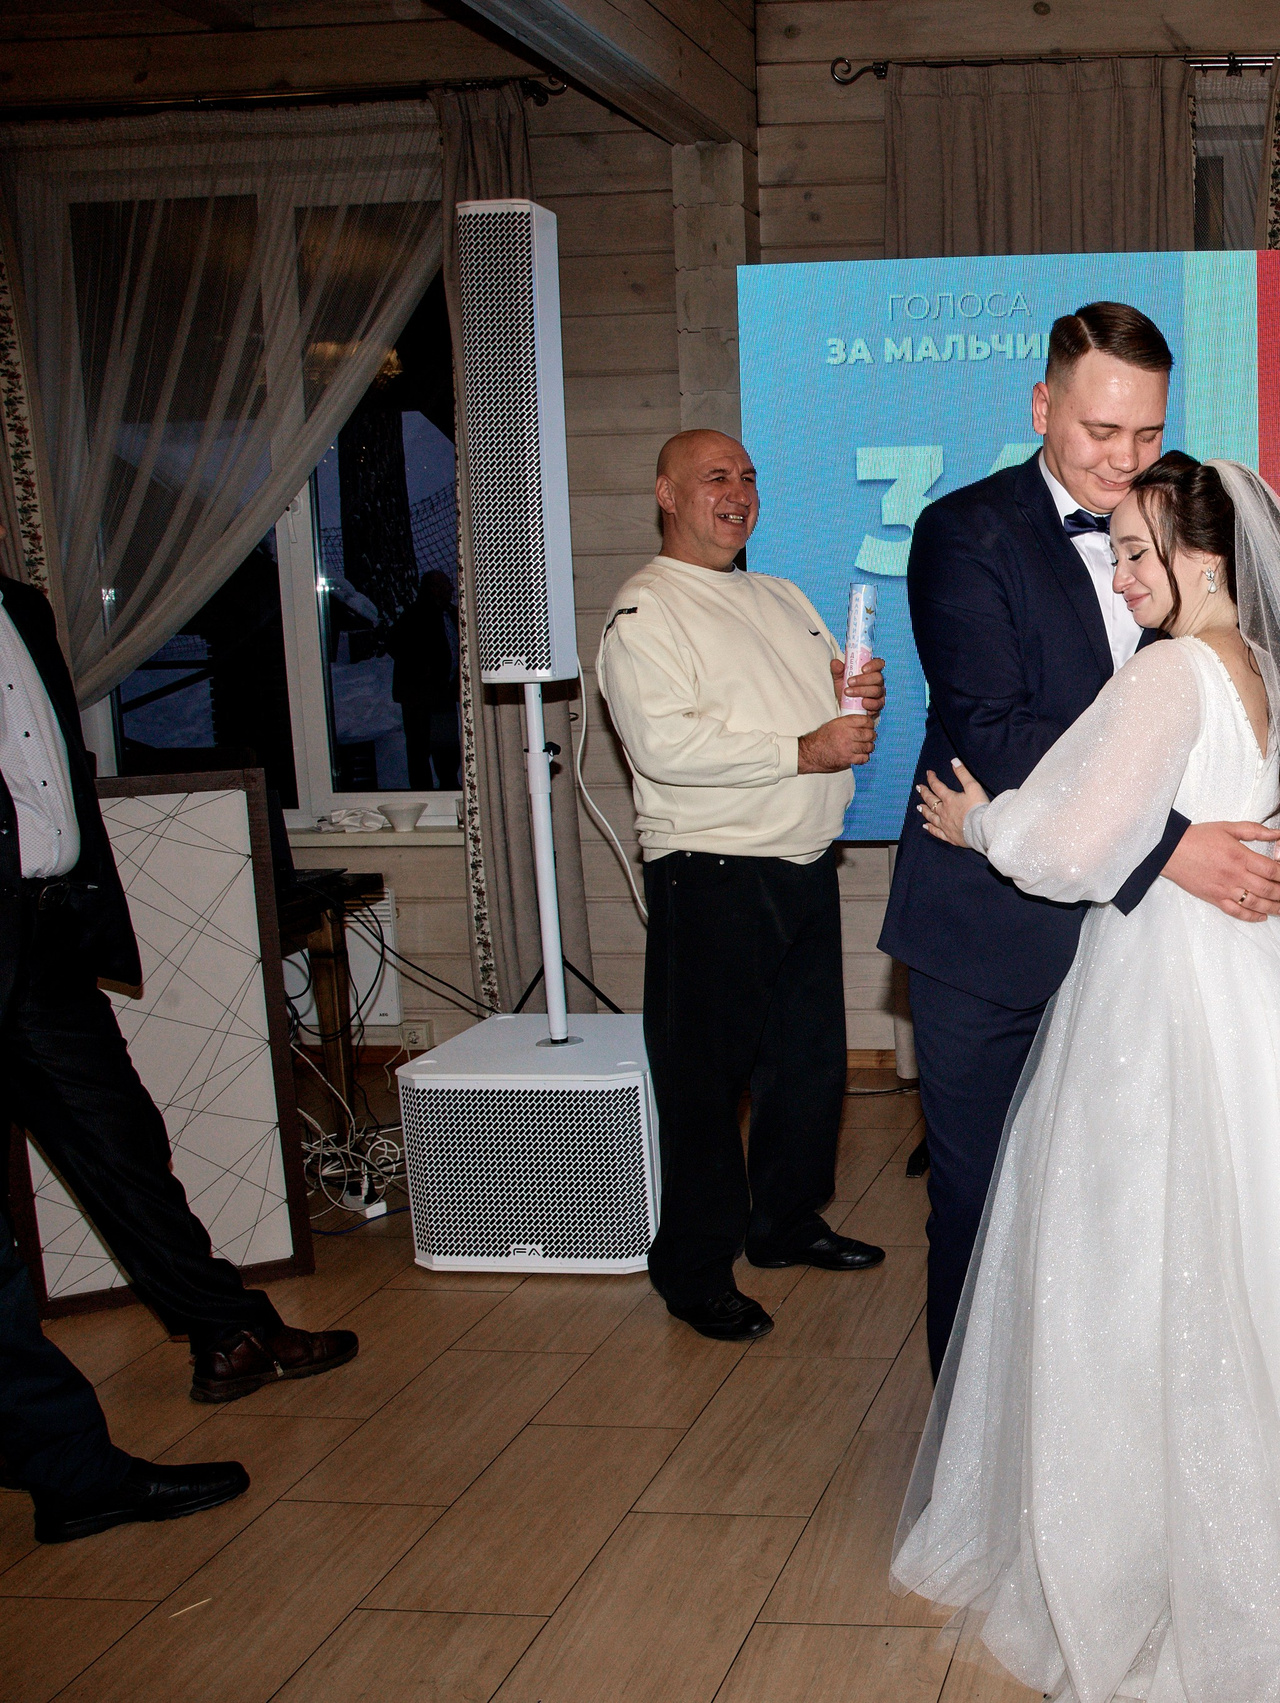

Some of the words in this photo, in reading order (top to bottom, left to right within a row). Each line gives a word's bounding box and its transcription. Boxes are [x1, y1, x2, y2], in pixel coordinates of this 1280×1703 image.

[888, 291, 1032, 320] ГОЛОСА
[826, 337, 875, 366] ЗА
[884, 333, 1050, 364] МАЛЬЧИ
[854, 443, 1043, 577] 3
